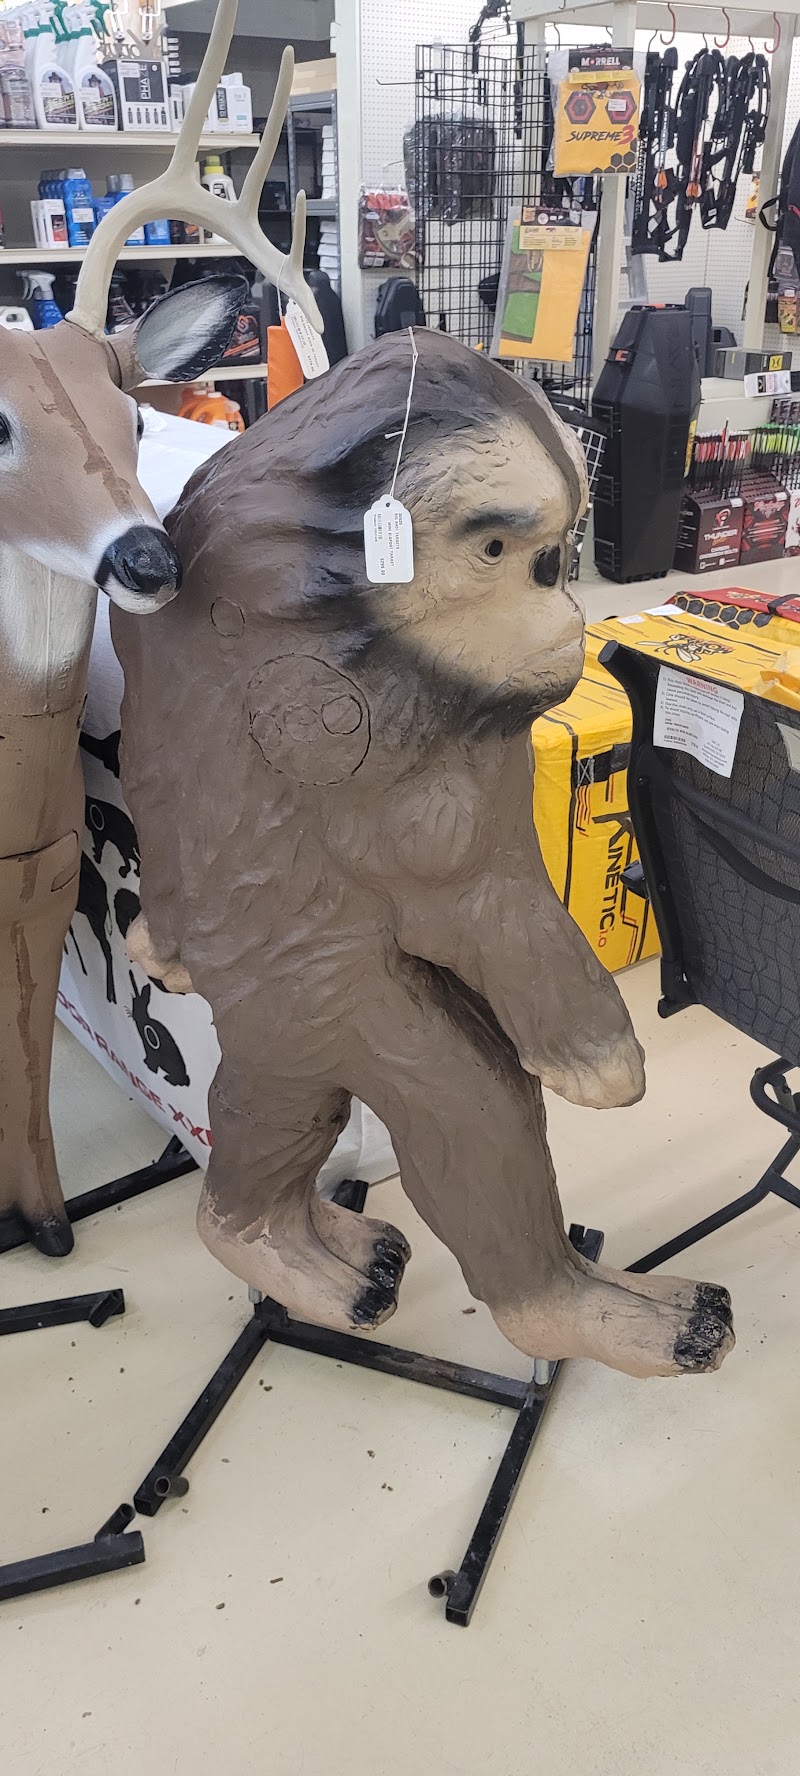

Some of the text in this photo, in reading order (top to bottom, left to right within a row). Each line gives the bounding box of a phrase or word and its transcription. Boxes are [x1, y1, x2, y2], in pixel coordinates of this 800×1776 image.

[703, 529, 738, 541] THUNDER
[686, 677, 718, 694] WARNING
[592, 810, 633, 931] KINETIC
